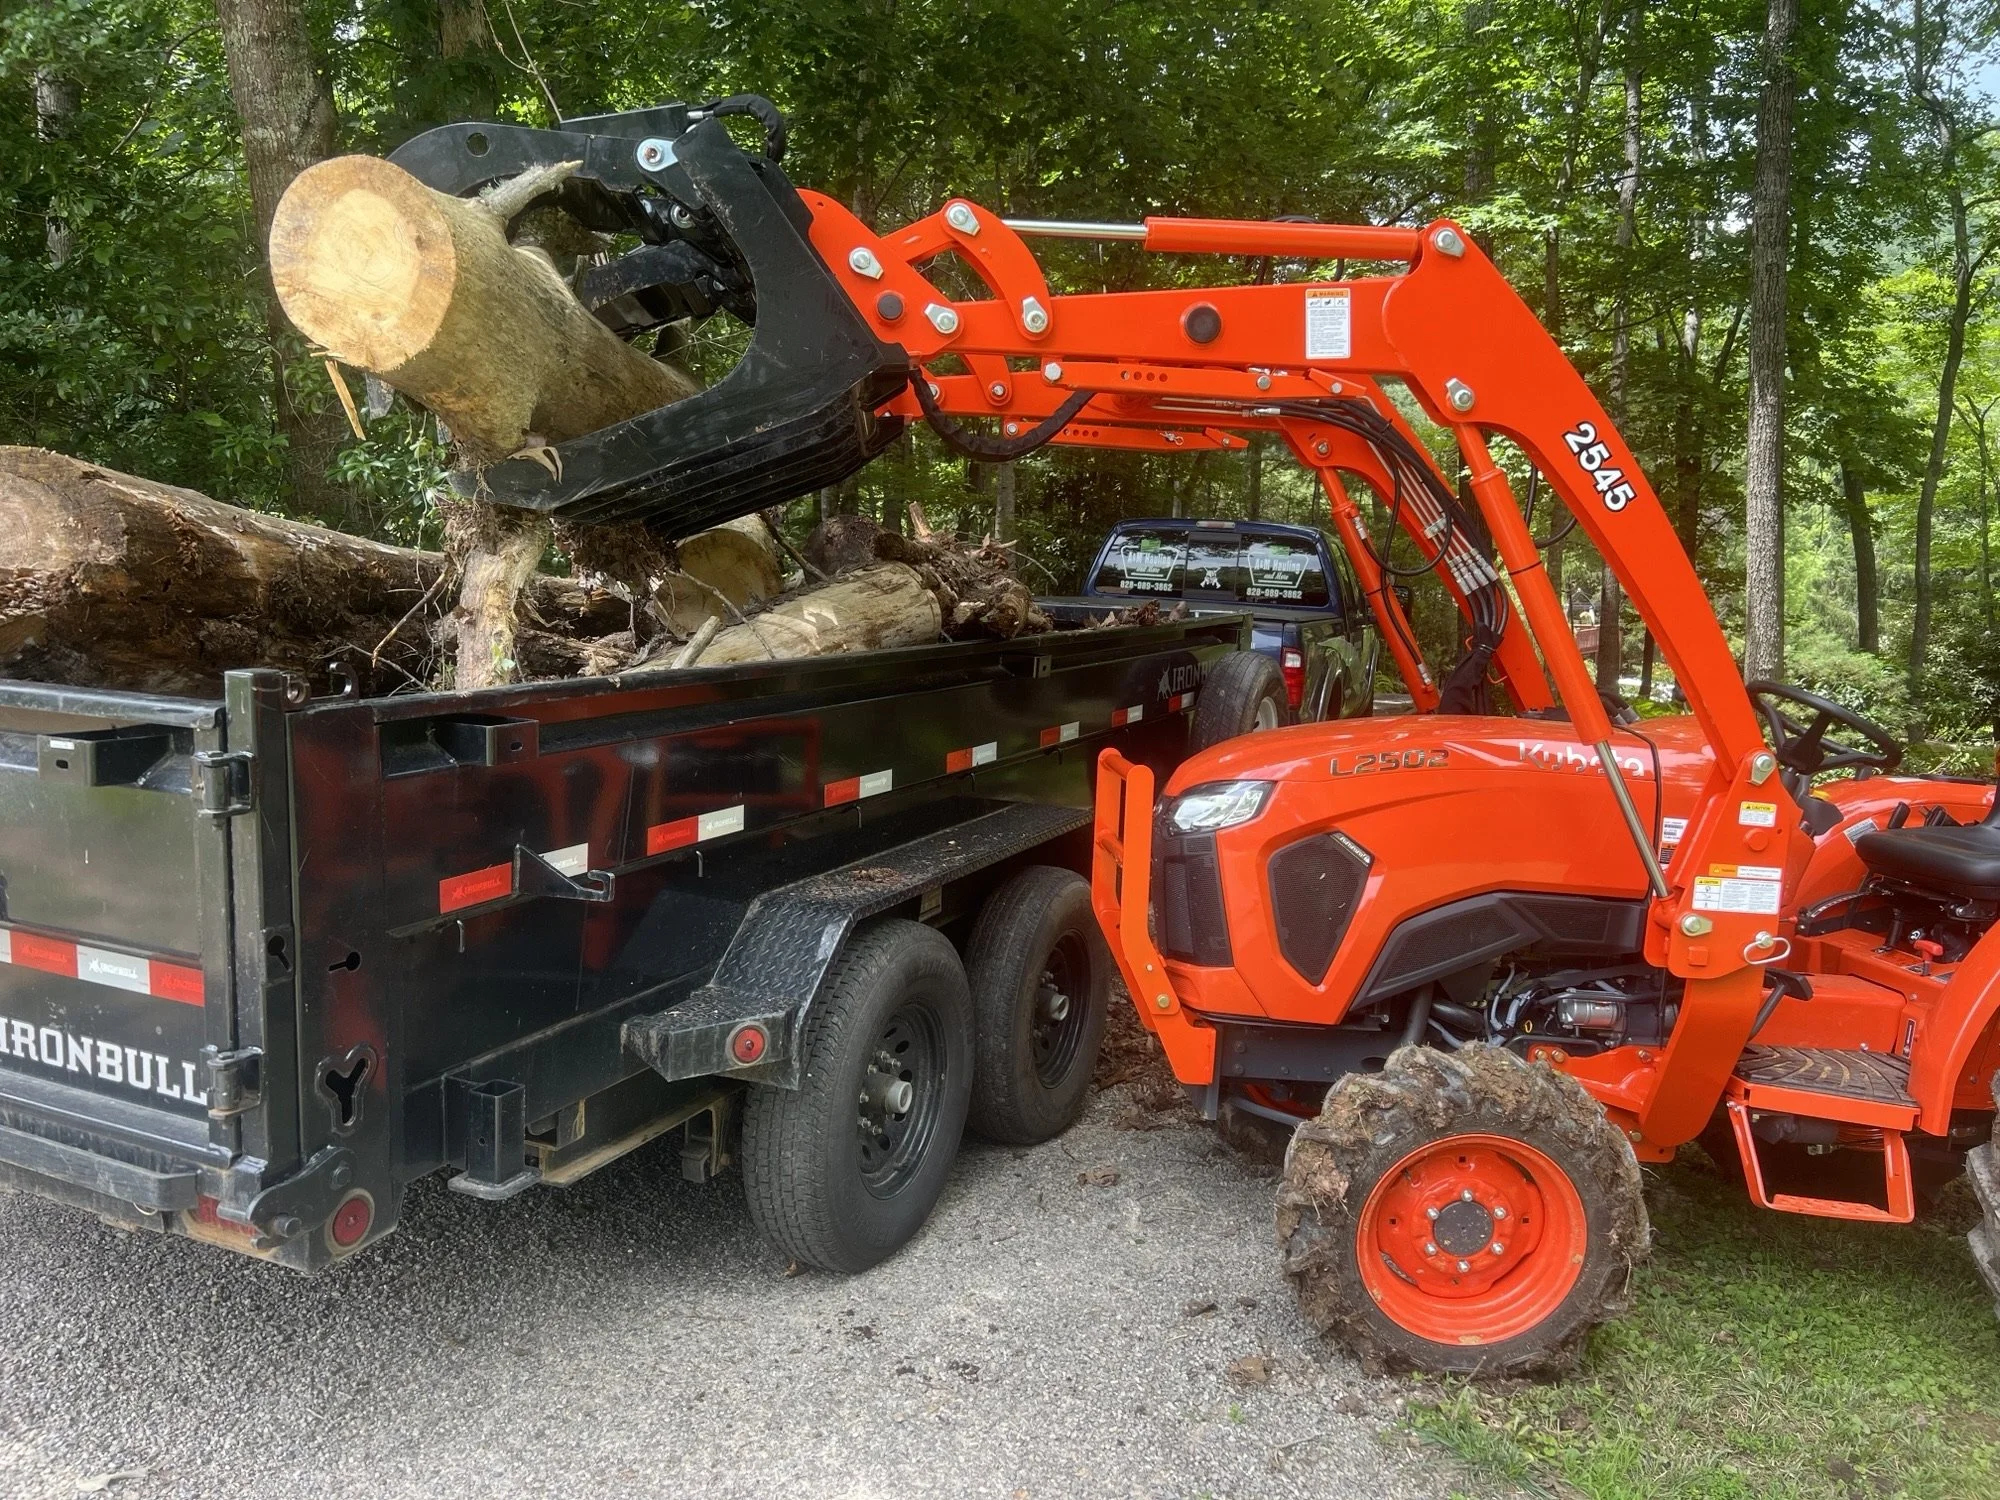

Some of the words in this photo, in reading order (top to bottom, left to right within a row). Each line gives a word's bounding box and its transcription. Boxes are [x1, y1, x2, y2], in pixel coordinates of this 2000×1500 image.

[1562, 421, 1637, 512] 2545
[1272, 559, 1301, 575] Hauling
[1330, 749, 1449, 776] L2502
[0, 1016, 207, 1106] IRONBULL
